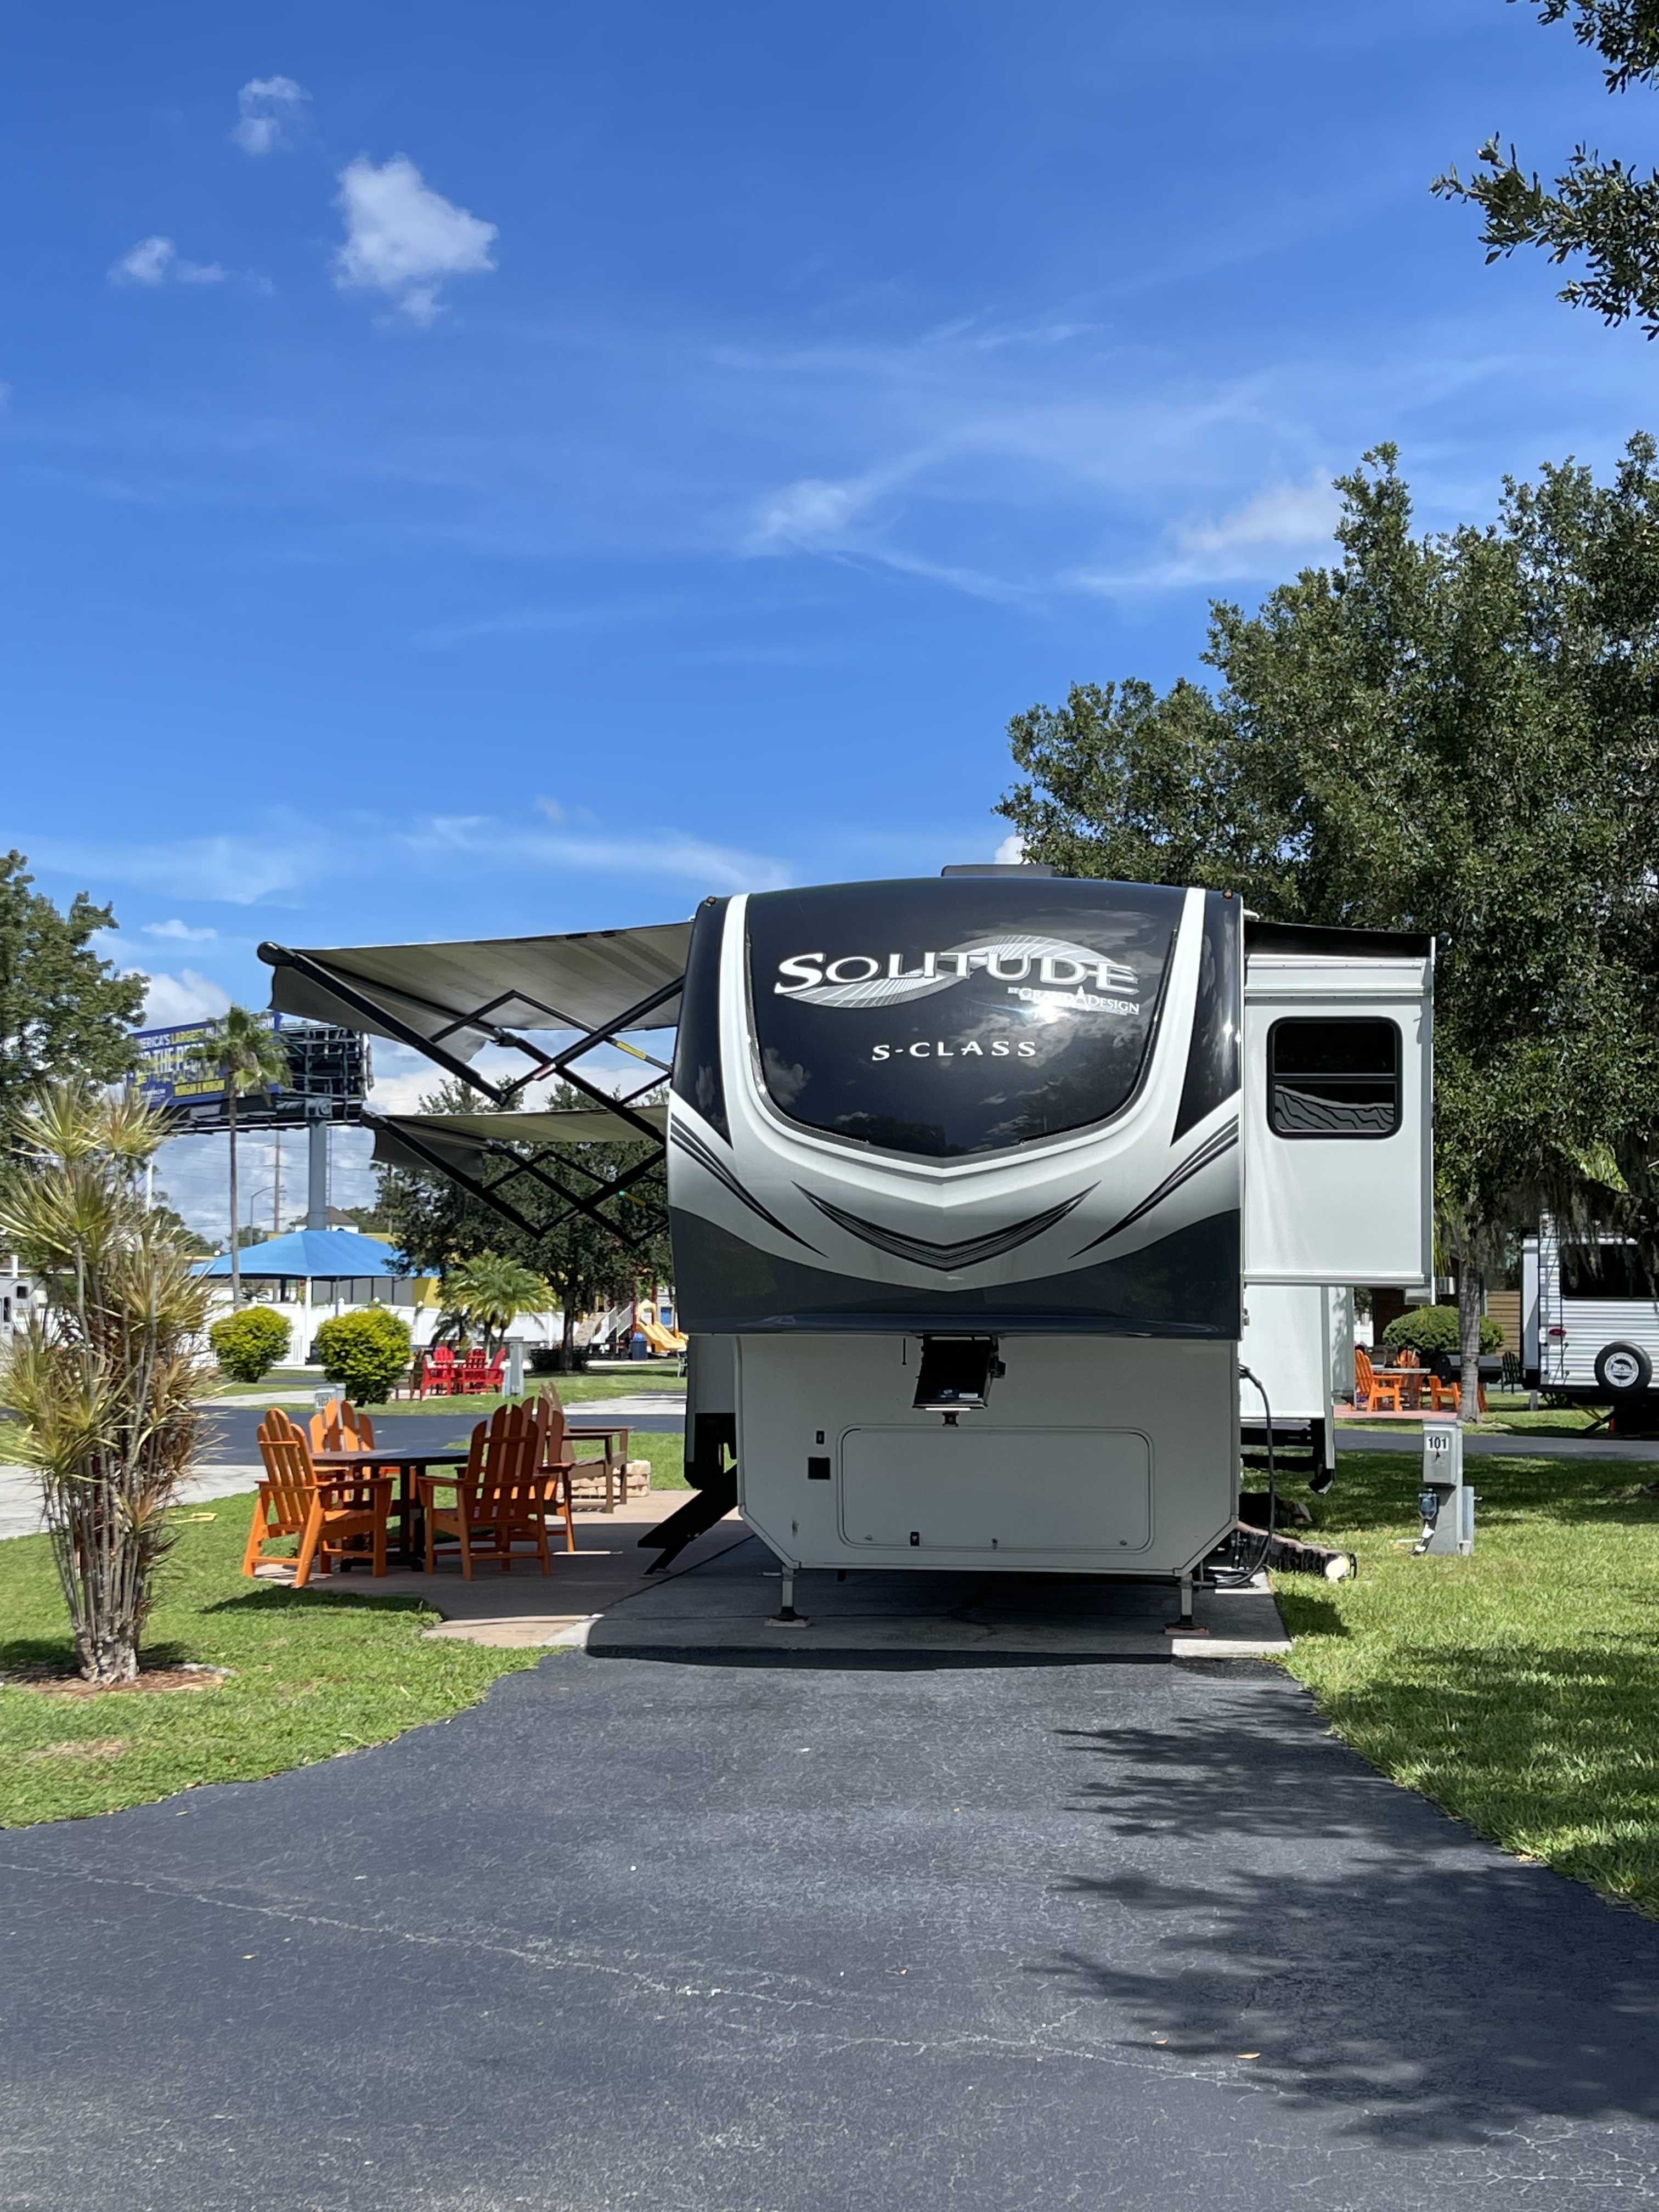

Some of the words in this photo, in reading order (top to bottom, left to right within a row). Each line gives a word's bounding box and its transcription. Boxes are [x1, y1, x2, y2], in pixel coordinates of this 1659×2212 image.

[774, 952, 1139, 994] SOLITUDE
[1088, 994, 1139, 1015] DESIGN
[872, 1041, 1036, 1061] S-CLASS
[1428, 1436, 1447, 1449] 101
